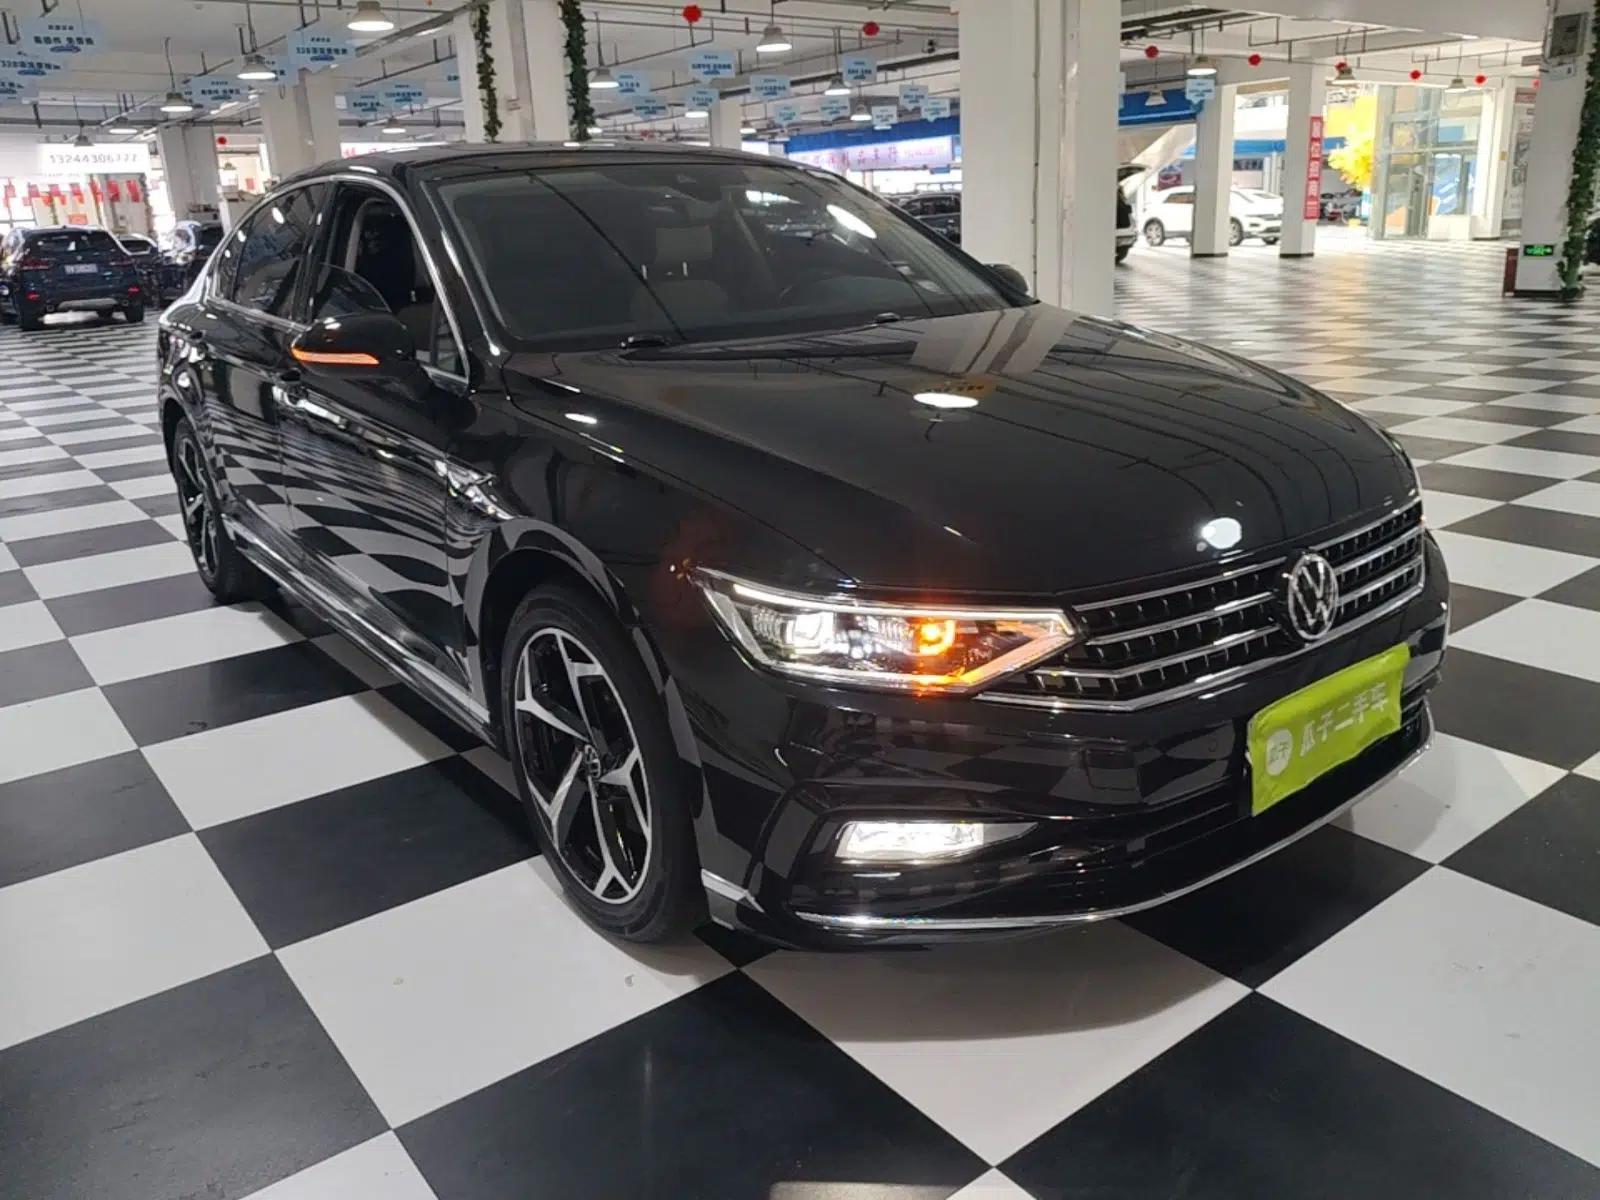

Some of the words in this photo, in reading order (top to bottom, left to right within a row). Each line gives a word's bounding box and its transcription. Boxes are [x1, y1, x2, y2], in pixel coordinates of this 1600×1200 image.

[1300, 682, 1388, 757] 瓜子二手车
